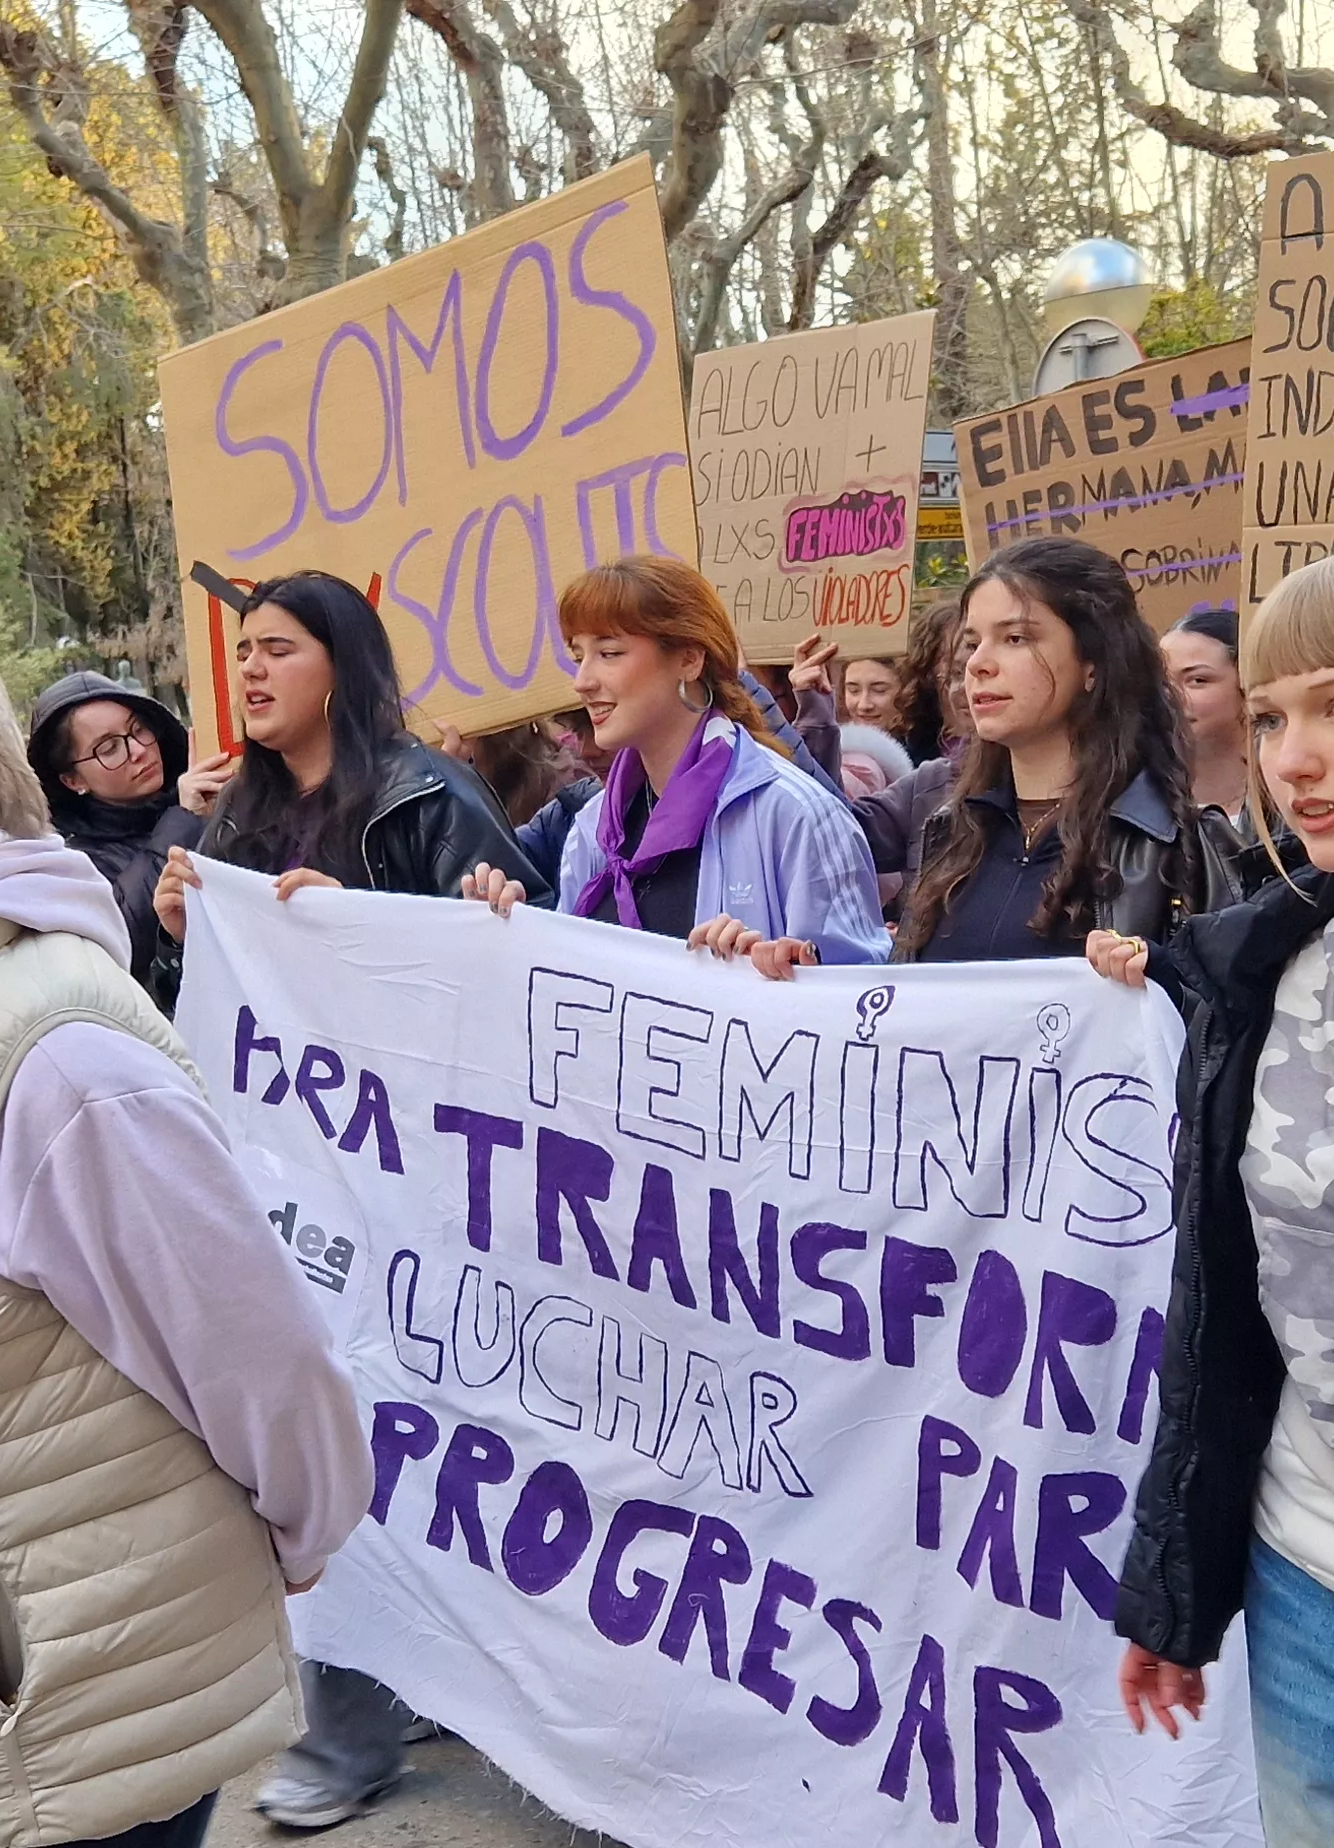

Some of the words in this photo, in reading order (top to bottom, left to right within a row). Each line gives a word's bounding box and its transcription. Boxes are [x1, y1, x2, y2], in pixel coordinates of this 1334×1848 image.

[1280, 173, 1325, 256] A
[215, 201, 656, 562] SOMOS
[697, 354, 799, 440] ALGO
[1081, 379, 1157, 456] ES
[712, 518, 776, 565] LXS
[762, 575, 811, 623] LOS
[528, 967, 1179, 1248] FEMINIS
[387, 1249, 813, 1498] LUCHAR
[367, 1401, 1063, 1848] PROGRESAR
